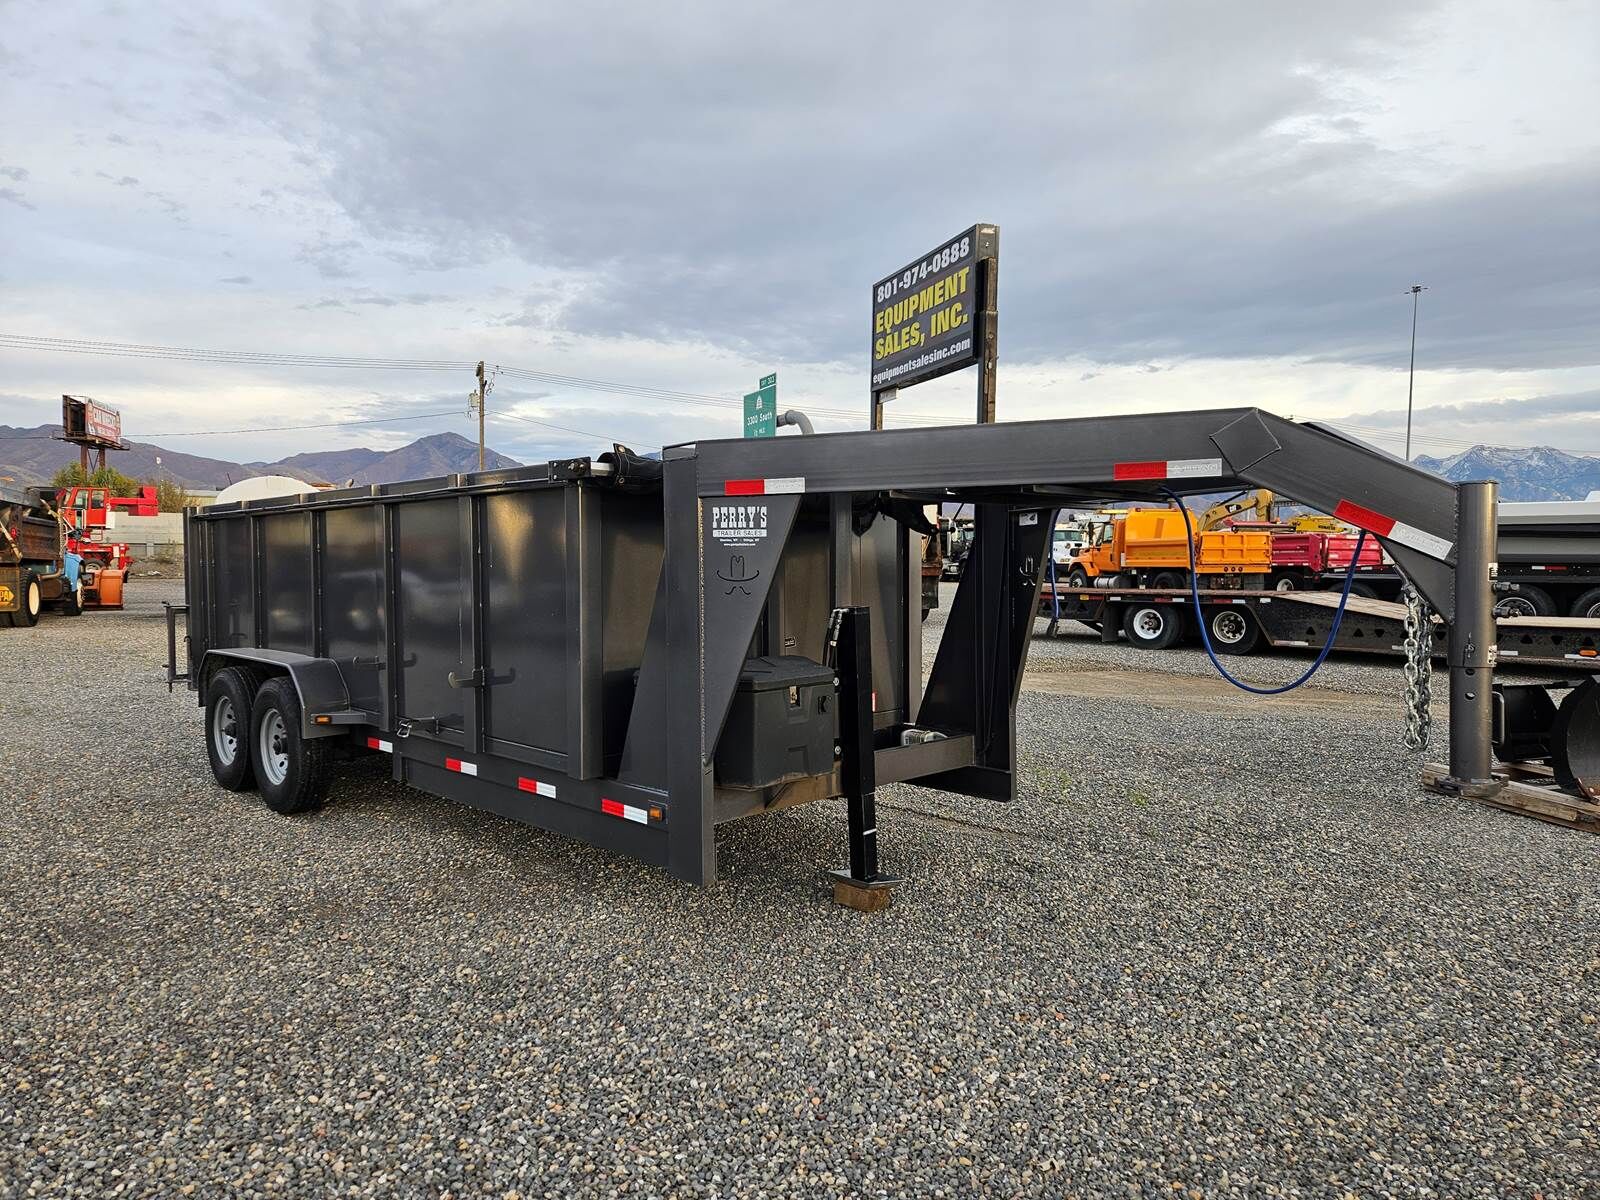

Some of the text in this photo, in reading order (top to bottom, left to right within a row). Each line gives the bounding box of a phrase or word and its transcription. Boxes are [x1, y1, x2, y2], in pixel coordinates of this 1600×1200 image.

[877, 236, 970, 303] 801-974-0888
[875, 266, 970, 334] EQUIPMENT
[875, 302, 969, 360] SALES, INC.
[872, 337, 971, 384] equipmentsalesinc.com
[760, 411, 773, 422] South
[712, 506, 767, 528] PERRY'S
